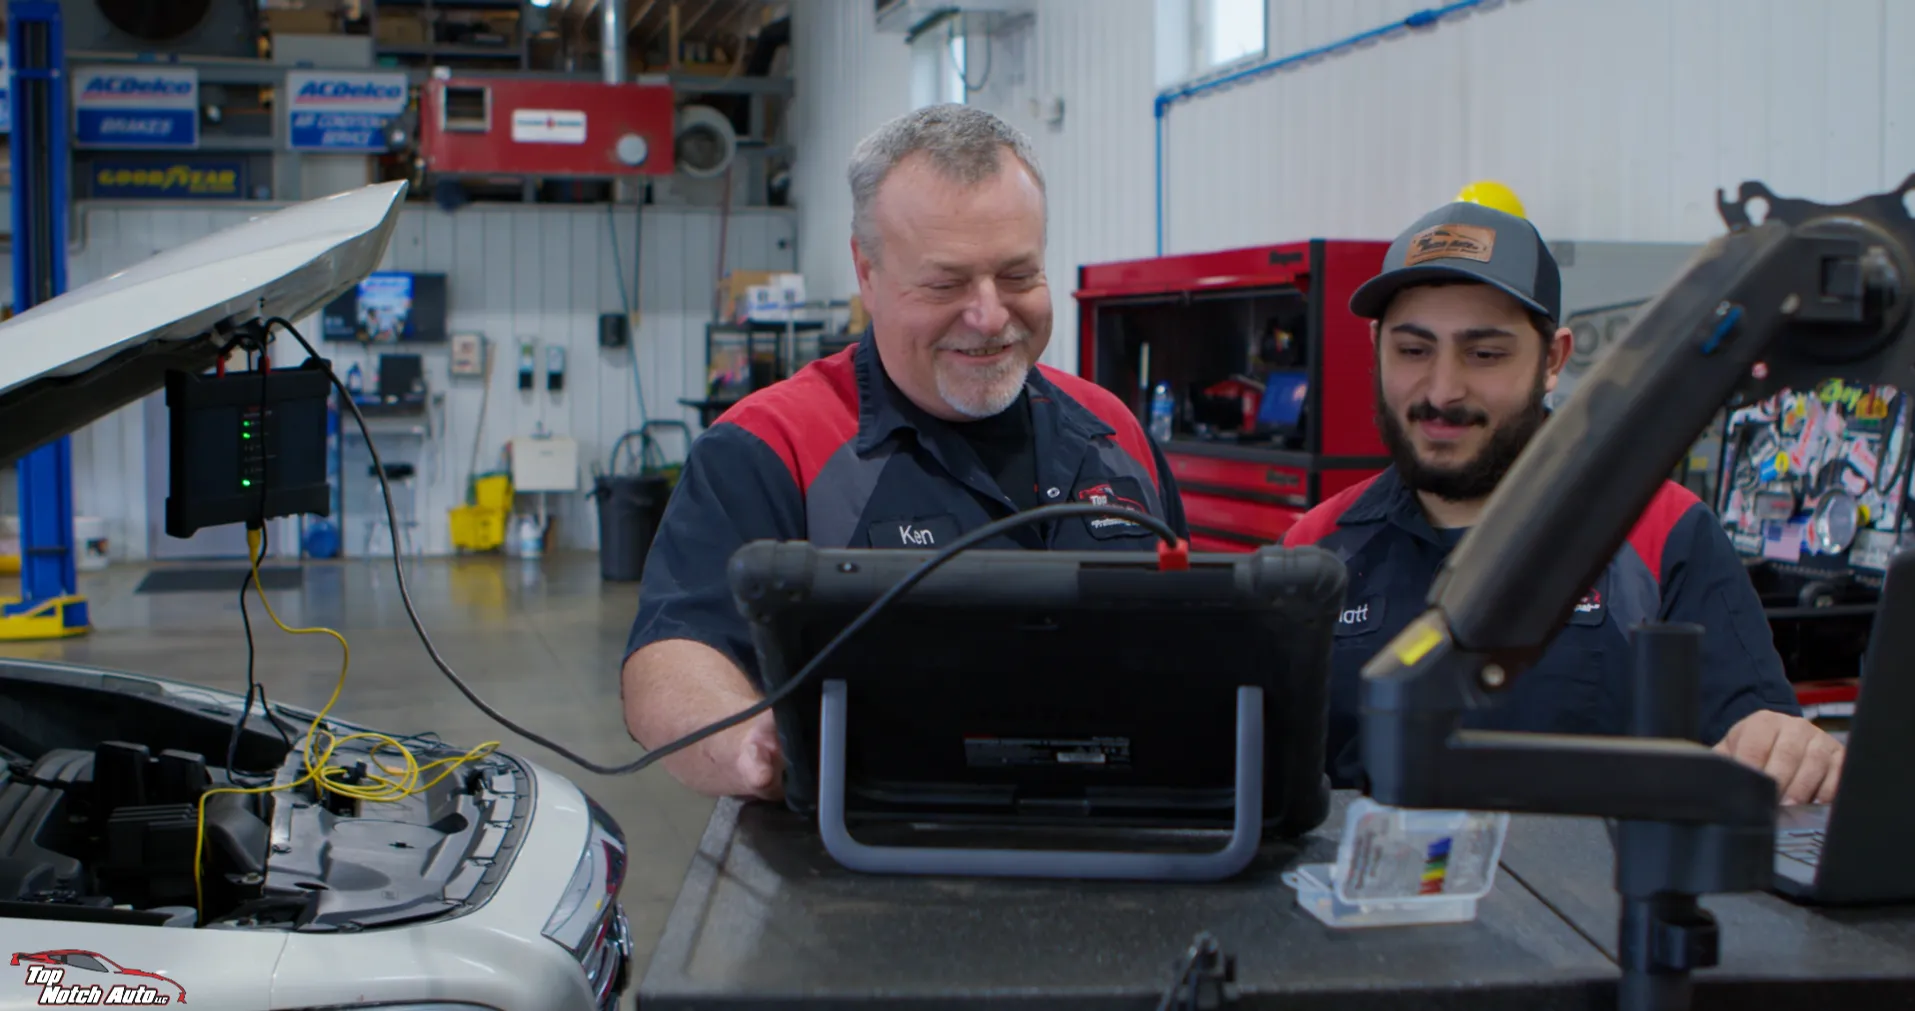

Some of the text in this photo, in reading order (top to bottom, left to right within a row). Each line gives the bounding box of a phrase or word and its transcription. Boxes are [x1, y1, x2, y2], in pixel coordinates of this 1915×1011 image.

[84, 75, 193, 95] ACDelco
[297, 81, 402, 98] ACDelco
[100, 116, 174, 136] BRAKES
[97, 165, 237, 190] GOODYEAR
[898, 524, 935, 546] Ken
